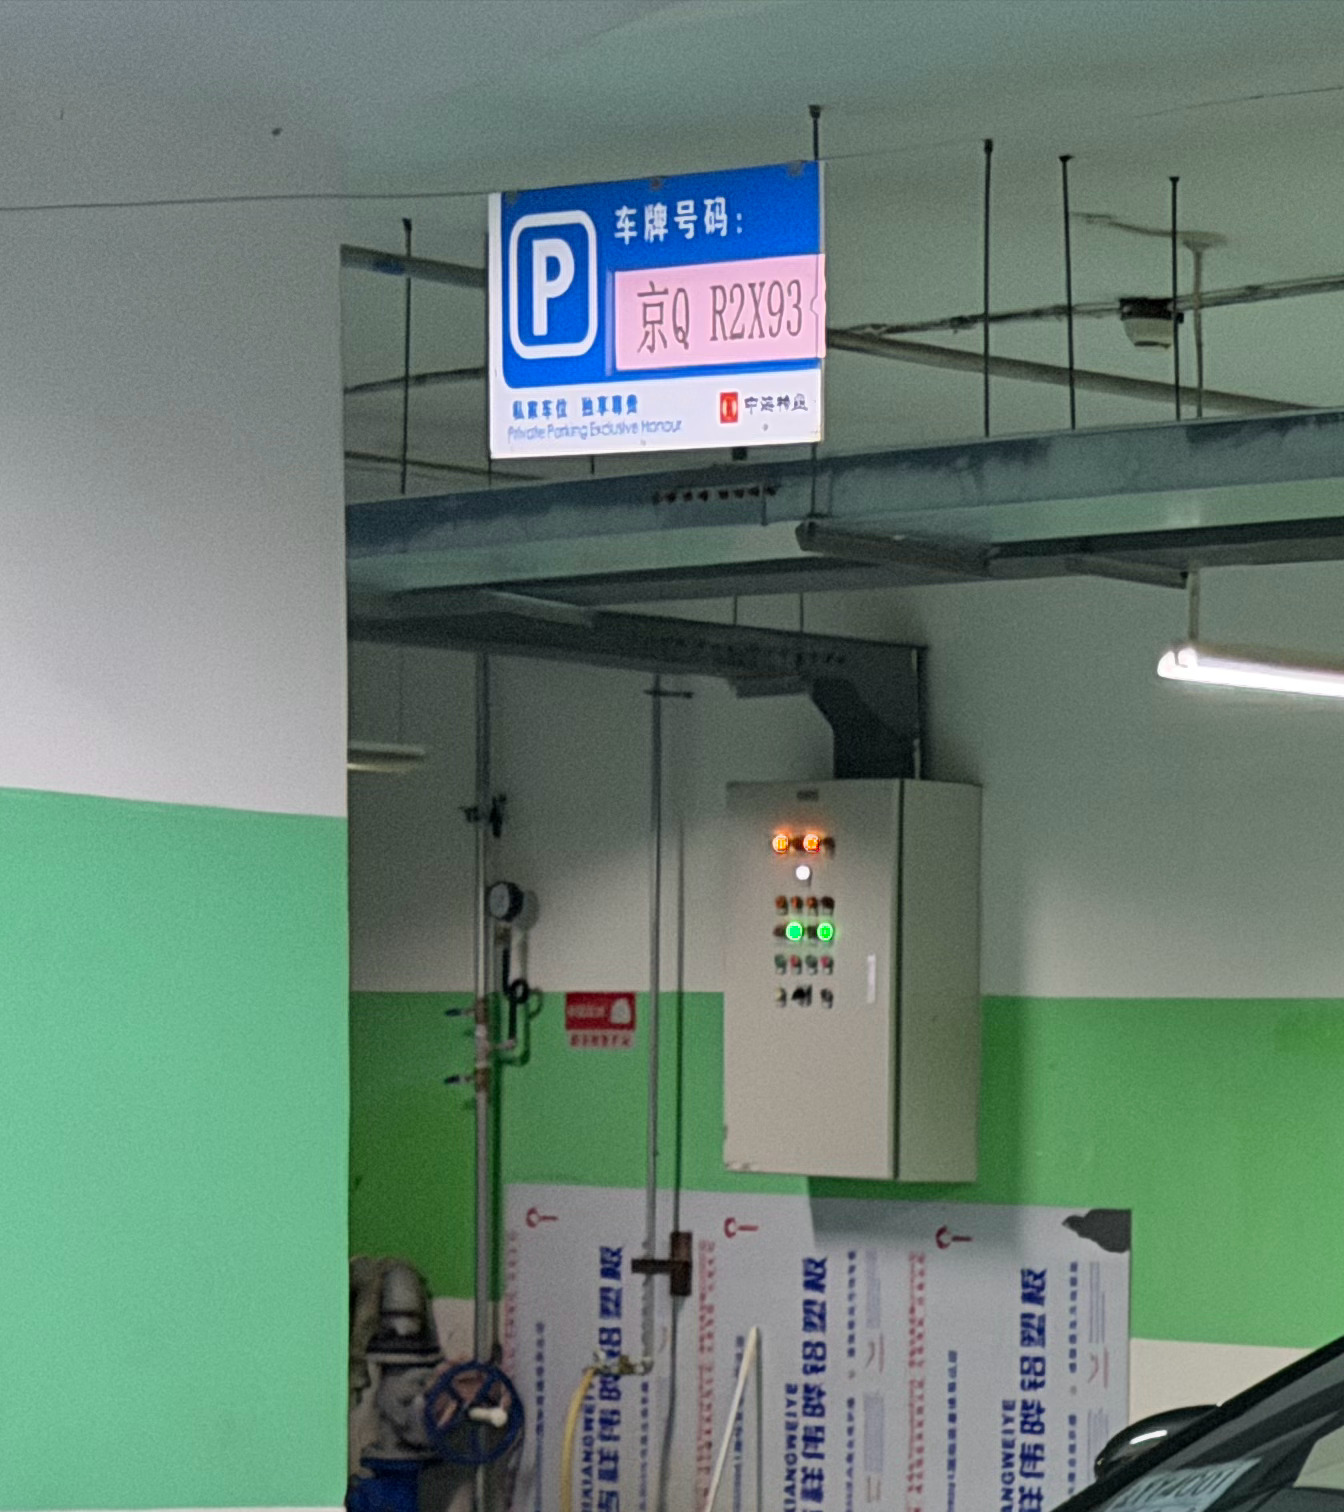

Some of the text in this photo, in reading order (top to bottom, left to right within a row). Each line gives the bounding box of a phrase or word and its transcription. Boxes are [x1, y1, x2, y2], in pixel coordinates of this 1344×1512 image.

[531, 238, 575, 337] P
[636, 278, 803, 354] 京Q R2X93
